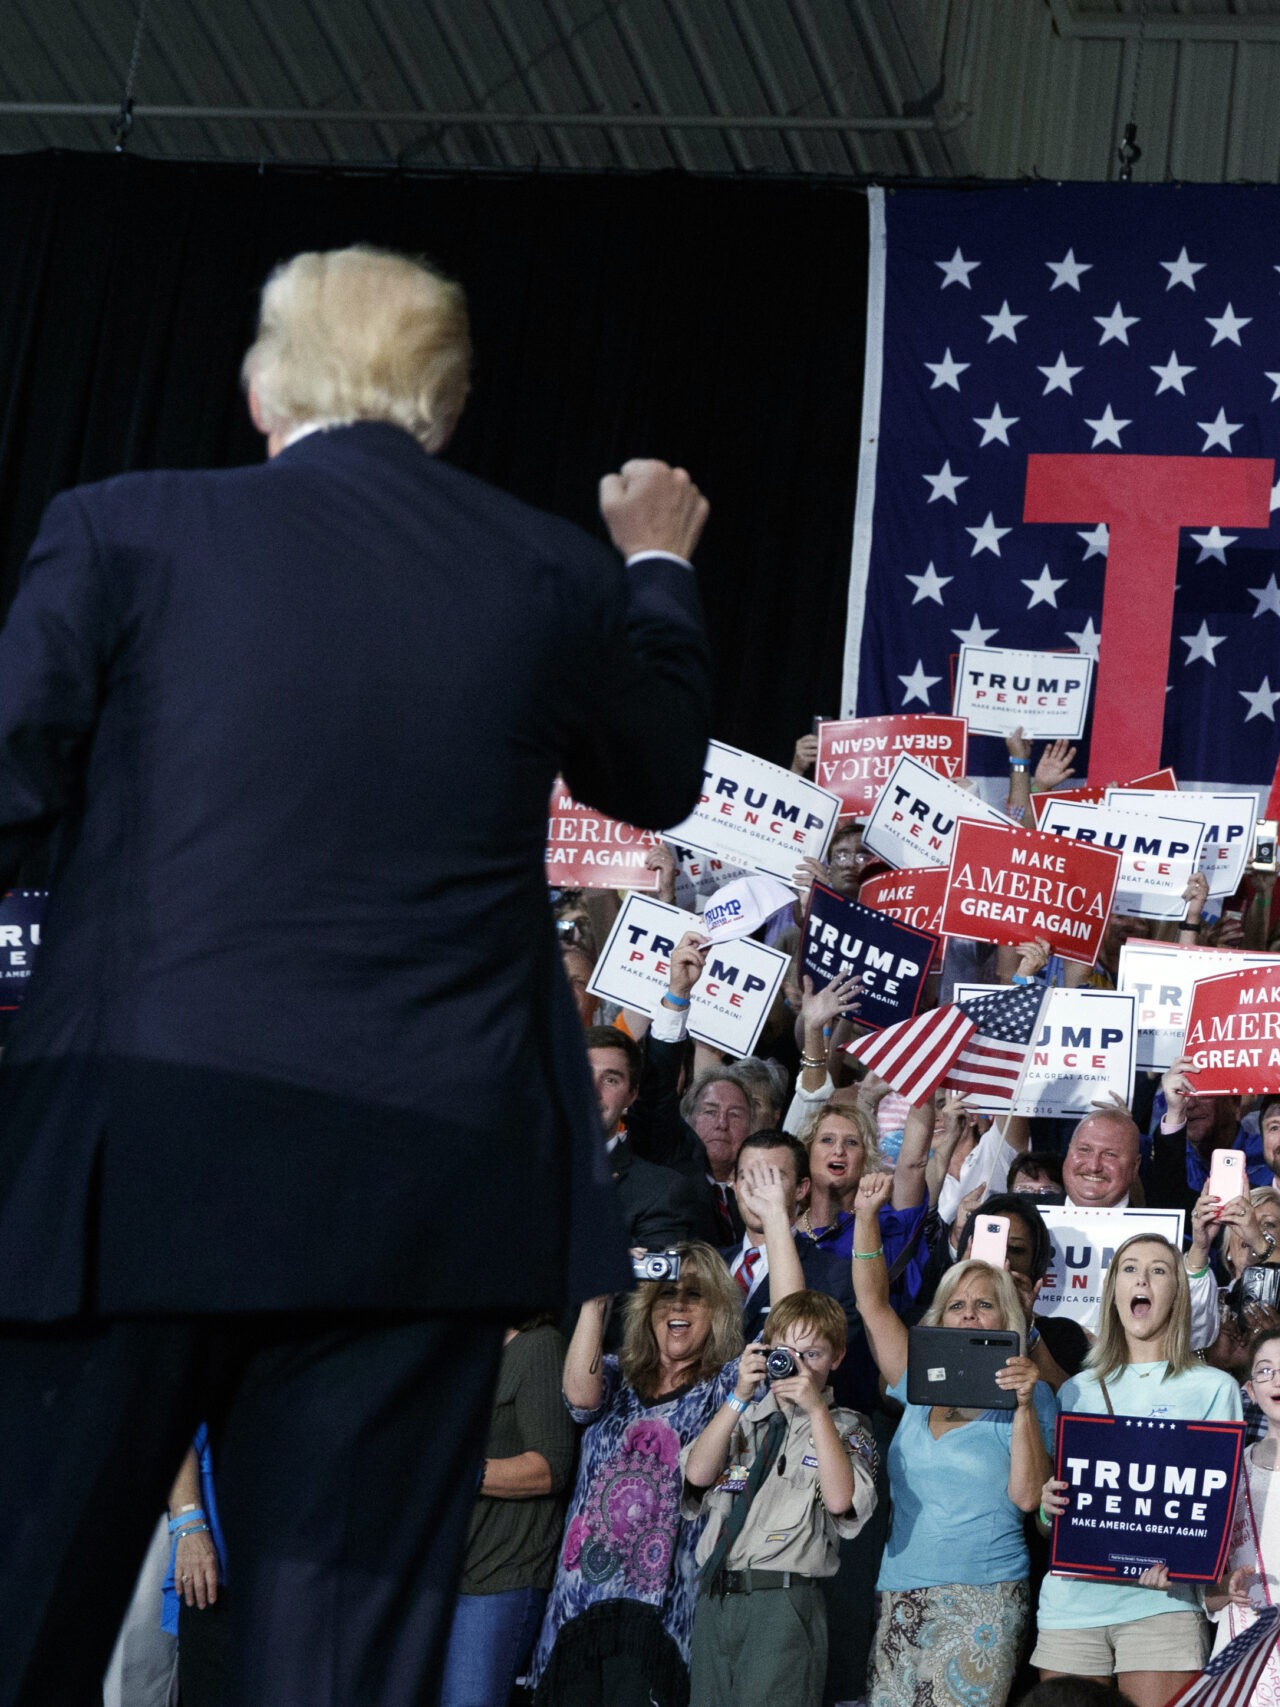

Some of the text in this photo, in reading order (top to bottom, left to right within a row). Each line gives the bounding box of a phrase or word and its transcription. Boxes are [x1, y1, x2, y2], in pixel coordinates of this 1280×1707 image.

[969, 671, 1080, 693] TRUMP
[976, 690, 1067, 706] PENCE
[832, 734, 952, 755] GREAT AGAIN
[696, 795, 807, 844] PENCE
[895, 785, 955, 835] TRU
[693, 811, 709, 819] AKE
[712, 817, 747, 833] AMERICA
[750, 830, 776, 844] GREAT
[892, 811, 942, 850] PEN
[545, 848, 647, 867] EAT AGAIN
[931, 855, 944, 866] GRE
[1011, 848, 1067, 873] MAKE
[877, 886, 915, 903] MAKE
[952, 863, 1105, 919] AMERICA
[960, 897, 1092, 941] GREAT AGAIN
[627, 924, 767, 993] TRMP
[809, 914, 919, 979] TRUMP
[629, 951, 745, 1007] PECE
[809, 941, 900, 995] PENCE
[620, 965, 742, 1020] MAKE AMER REAT AGAIN!
[816, 967, 835, 980] AMERI
[870, 992, 899, 1007] AGAIN!
[1036, 1025, 1124, 1049] UMP
[1034, 1053, 1106, 1068] NCE
[1192, 1047, 1263, 1069] GREAT
[1026, 1106, 1053, 1114] 2016
[1066, 1457, 1228, 1497] TRUMP
[1076, 1492, 1208, 1521] PENCE
[1071, 1518, 1208, 1537] MAKE AMERICA GREAT AGAIN!
